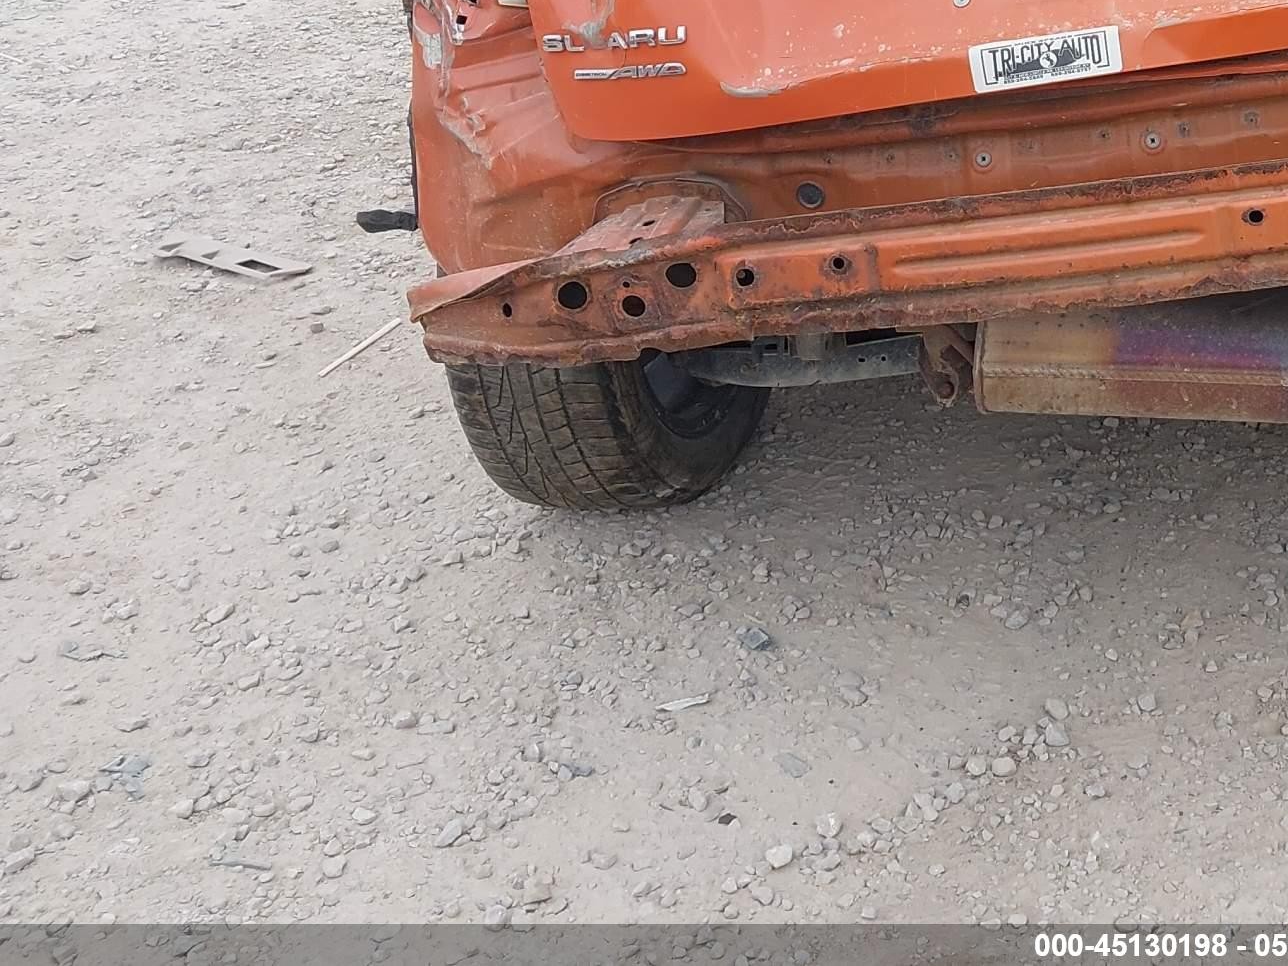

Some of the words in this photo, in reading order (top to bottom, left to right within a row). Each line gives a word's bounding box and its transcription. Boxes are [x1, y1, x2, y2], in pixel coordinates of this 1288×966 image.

[542, 25, 688, 52] SARU
[1059, 34, 1102, 65] AUTO
[609, 62, 687, 80] AWD
